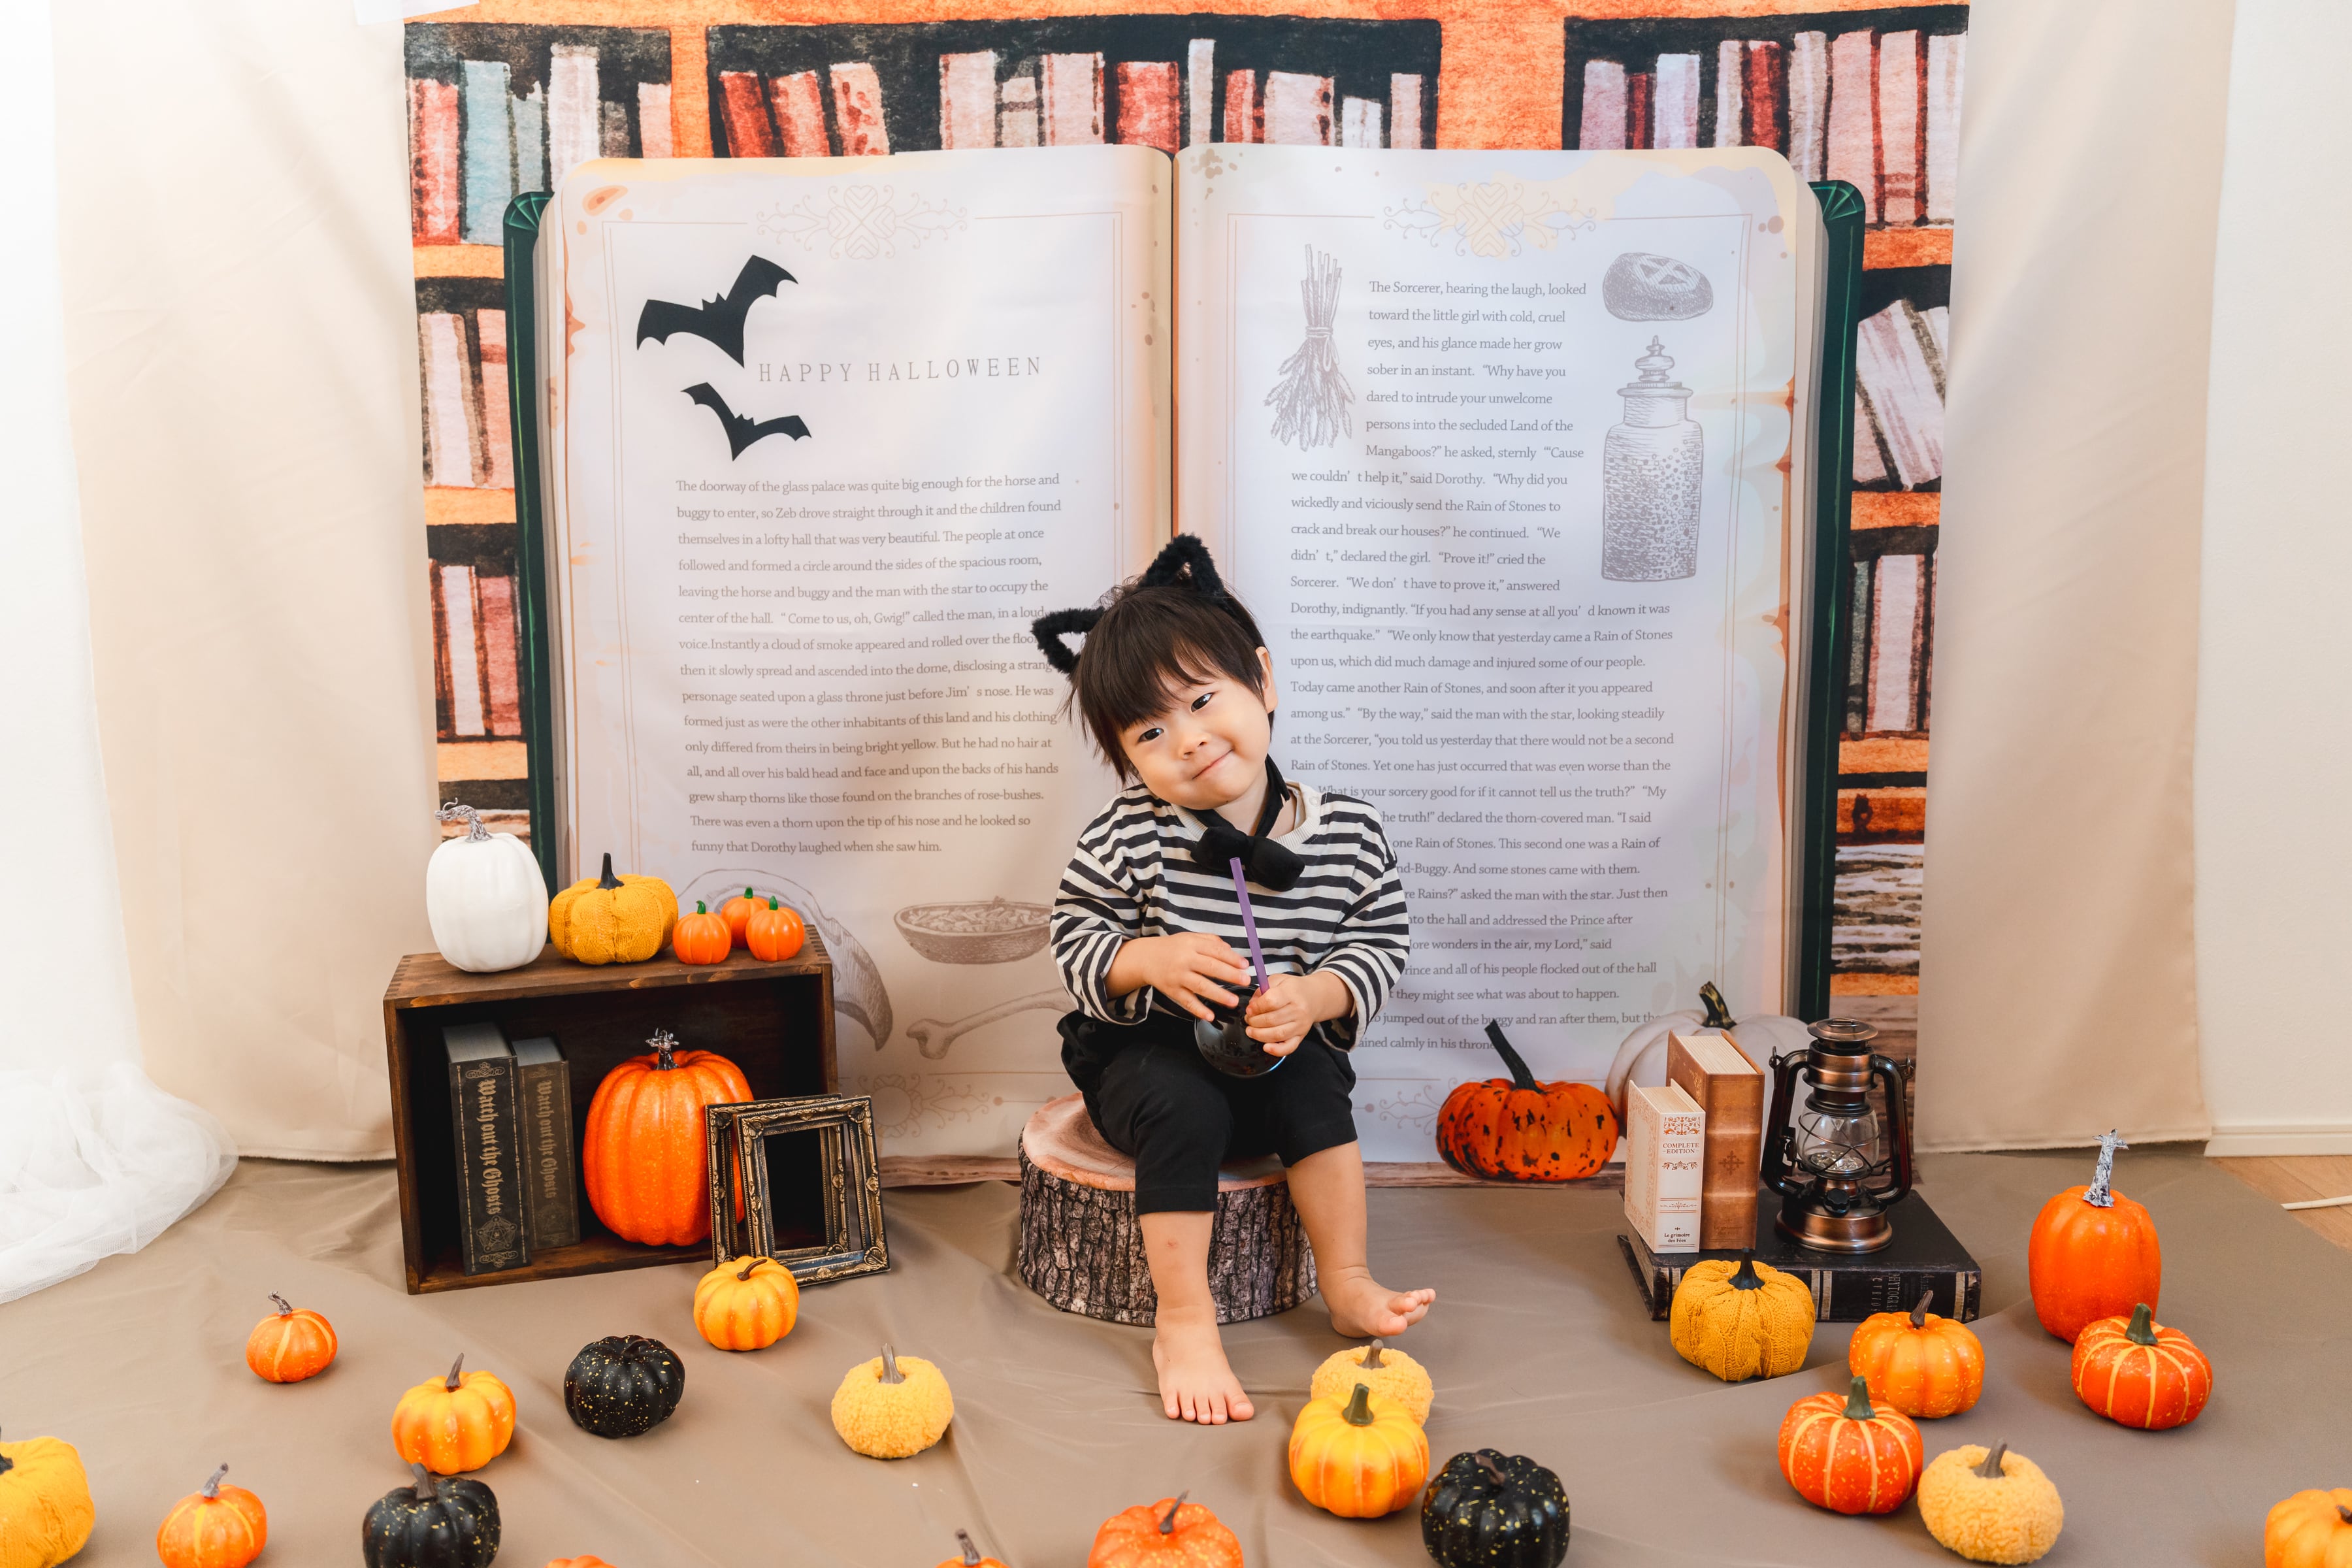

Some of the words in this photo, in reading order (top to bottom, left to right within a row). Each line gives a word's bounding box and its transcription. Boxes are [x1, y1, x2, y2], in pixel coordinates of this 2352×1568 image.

[1369, 281, 1390, 292] The
[1393, 282, 1443, 295] Sorcerer,
[1446, 282, 1488, 297] hearing
[1491, 283, 1509, 294] the
[1512, 283, 1545, 298] laugh,
[1548, 283, 1586, 295] looked
[1369, 308, 1410, 320] toward
[1413, 308, 1431, 320] the
[1433, 309, 1459, 321] little
[1461, 310, 1479, 324] girl
[1482, 310, 1507, 321] with
[1510, 310, 1535, 323] cold,
[1538, 310, 1565, 322] cruel
[759, 363, 852, 382] HAPPY
[868, 357, 1041, 381] HALLOWEEN
[1367, 390, 1398, 402] dared
[1401, 393, 1413, 402] to
[1416, 391, 1458, 402] intrude
[1460, 395, 1486, 406] your
[1488, 392, 1552, 404] unwelcome
[676, 480, 696, 491] The
[700, 480, 746, 495] doorway
[749, 481, 760, 491] of
[762, 481, 779, 491] the
[783, 481, 809, 495] glass
[811, 480, 845, 495] palace
[871, 480, 899, 494] quite
[902, 478, 919, 493] big
[921, 477, 963, 491] enough
[966, 476, 982, 487] for
[985, 476, 1002, 487] the
[1005, 475, 1036, 485] horse
[1038, 473, 1060, 485] and
[677, 506, 711, 521] buggy
[713, 509, 725, 517] to
[727, 509, 758, 519] enter,
[776, 507, 796, 518] Zeb
[799, 507, 830, 518] drove
[833, 506, 875, 521] straight
[878, 504, 923, 519] through
[926, 506, 934, 515] it
[936, 504, 957, 515] and
[960, 503, 977, 514] the
[980, 502, 1025, 514] children
[1028, 499, 1061, 512] found
[679, 559, 726, 570] followed
[728, 560, 749, 571] and
[752, 560, 792, 571] formed
[803, 560, 830, 571] circle
[833, 559, 873, 571] around
[875, 559, 893, 570] the
[896, 558, 923, 570] sides
[925, 557, 937, 568] of
[939, 557, 956, 568] the
[960, 557, 1006, 570] spacious
[1009, 557, 1041, 566] room,
[1290, 681, 1324, 695] Today
[1357, 681, 1401, 693] another
[1404, 683, 1428, 693] Rain
[1431, 682, 1443, 693] of
[1445, 683, 1484, 695] Stones,
[1486, 682, 1507, 693] and
[1539, 683, 1565, 694] after
[1568, 683, 1576, 693] it
[1578, 686, 1599, 696] you
[1601, 681, 1653, 696] appeared
[685, 741, 709, 755] only
[711, 741, 753, 753] differed
[756, 742, 783, 753] from
[785, 742, 817, 753] theirs
[819, 743, 830, 753] in
[832, 742, 864, 756] being
[865, 740, 899, 755] bright
[901, 738, 938, 753] yellow.
[941, 738, 960, 748] But
[963, 737, 976, 748] he
[979, 737, 998, 747] had
[1017, 737, 1039, 747] hair
[1041, 739, 1052, 747] at
[689, 794, 715, 804] grew
[717, 791, 747, 806] sharp
[749, 792, 785, 804] thorns
[788, 792, 807, 803] like
[809, 792, 840, 803] those
[842, 791, 875, 802] found
[894, 790, 912, 800] the
[915, 789, 962, 800] branches
[964, 789, 975, 800] of
[977, 789, 1043, 800] rose-bushes.
[692, 840, 724, 854] funny
[727, 841, 749, 852] that
[751, 841, 796, 855] Dorothy
[798, 841, 841, 855] laughed
[844, 841, 874, 851] when
[876, 841, 894, 851] she
[918, 840, 941, 851] him.
[1453, 863, 1477, 874] And
[1511, 866, 1546, 875] stones
[1580, 864, 1605, 874] with
[1609, 863, 1640, 874] them.
[1460, 889, 1492, 900] asked
[1494, 889, 1512, 900] the
[1543, 889, 1567, 900] with
[1570, 889, 1588, 900] the
[1590, 891, 1614, 900] star.
[1616, 889, 1641, 899] Just
[1643, 887, 1667, 898] then
[1432, 939, 1478, 949] wonders
[1480, 939, 1491, 949] in
[1494, 939, 1512, 949] the
[1514, 939, 1531, 951] air,
[1535, 942, 1552, 952] my
[1590, 938, 1612, 949] said
[1396, 989, 1420, 1002] they
[1422, 989, 1454, 1003] might
[1476, 988, 1503, 999] what
[1528, 988, 1560, 999] about
[1576, 988, 1619, 1002] happen.
[476, 1079, 499, 1122] Watch
[536, 1079, 555, 1119] Watch
[480, 1123, 500, 1145] out
[540, 1119, 555, 1137] out
[480, 1145, 502, 1166] the
[538, 1138, 557, 1156] the
[540, 1156, 559, 1200] Ghosts
[482, 1167, 504, 1215] Ghosts
